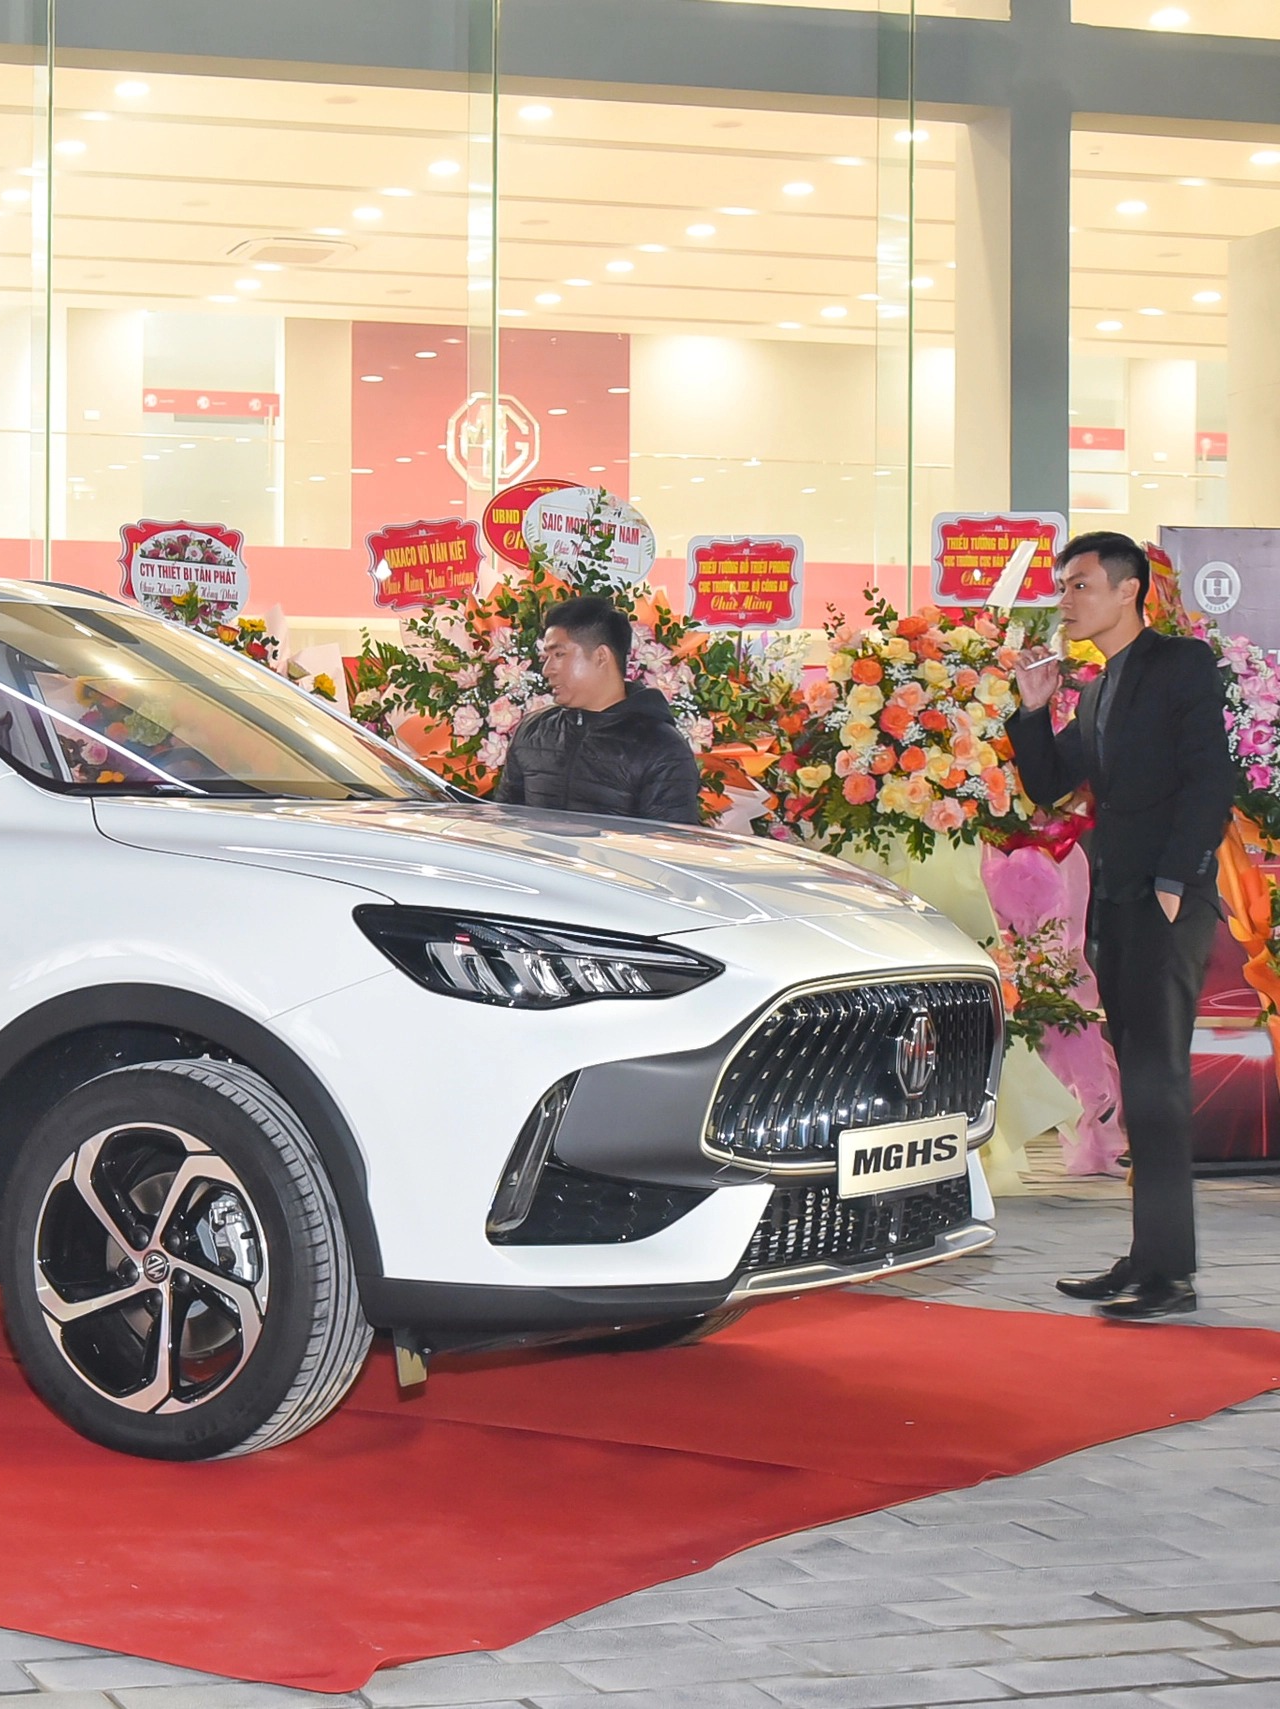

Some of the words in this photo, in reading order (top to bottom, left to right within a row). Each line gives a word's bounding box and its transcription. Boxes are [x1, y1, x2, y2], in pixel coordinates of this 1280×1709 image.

[492, 509, 520, 524] UBND
[542, 512, 563, 533] SAIC
[619, 525, 640, 545] NAM
[140, 562, 156, 578] CTY
[852, 1134, 959, 1177] MGHS
